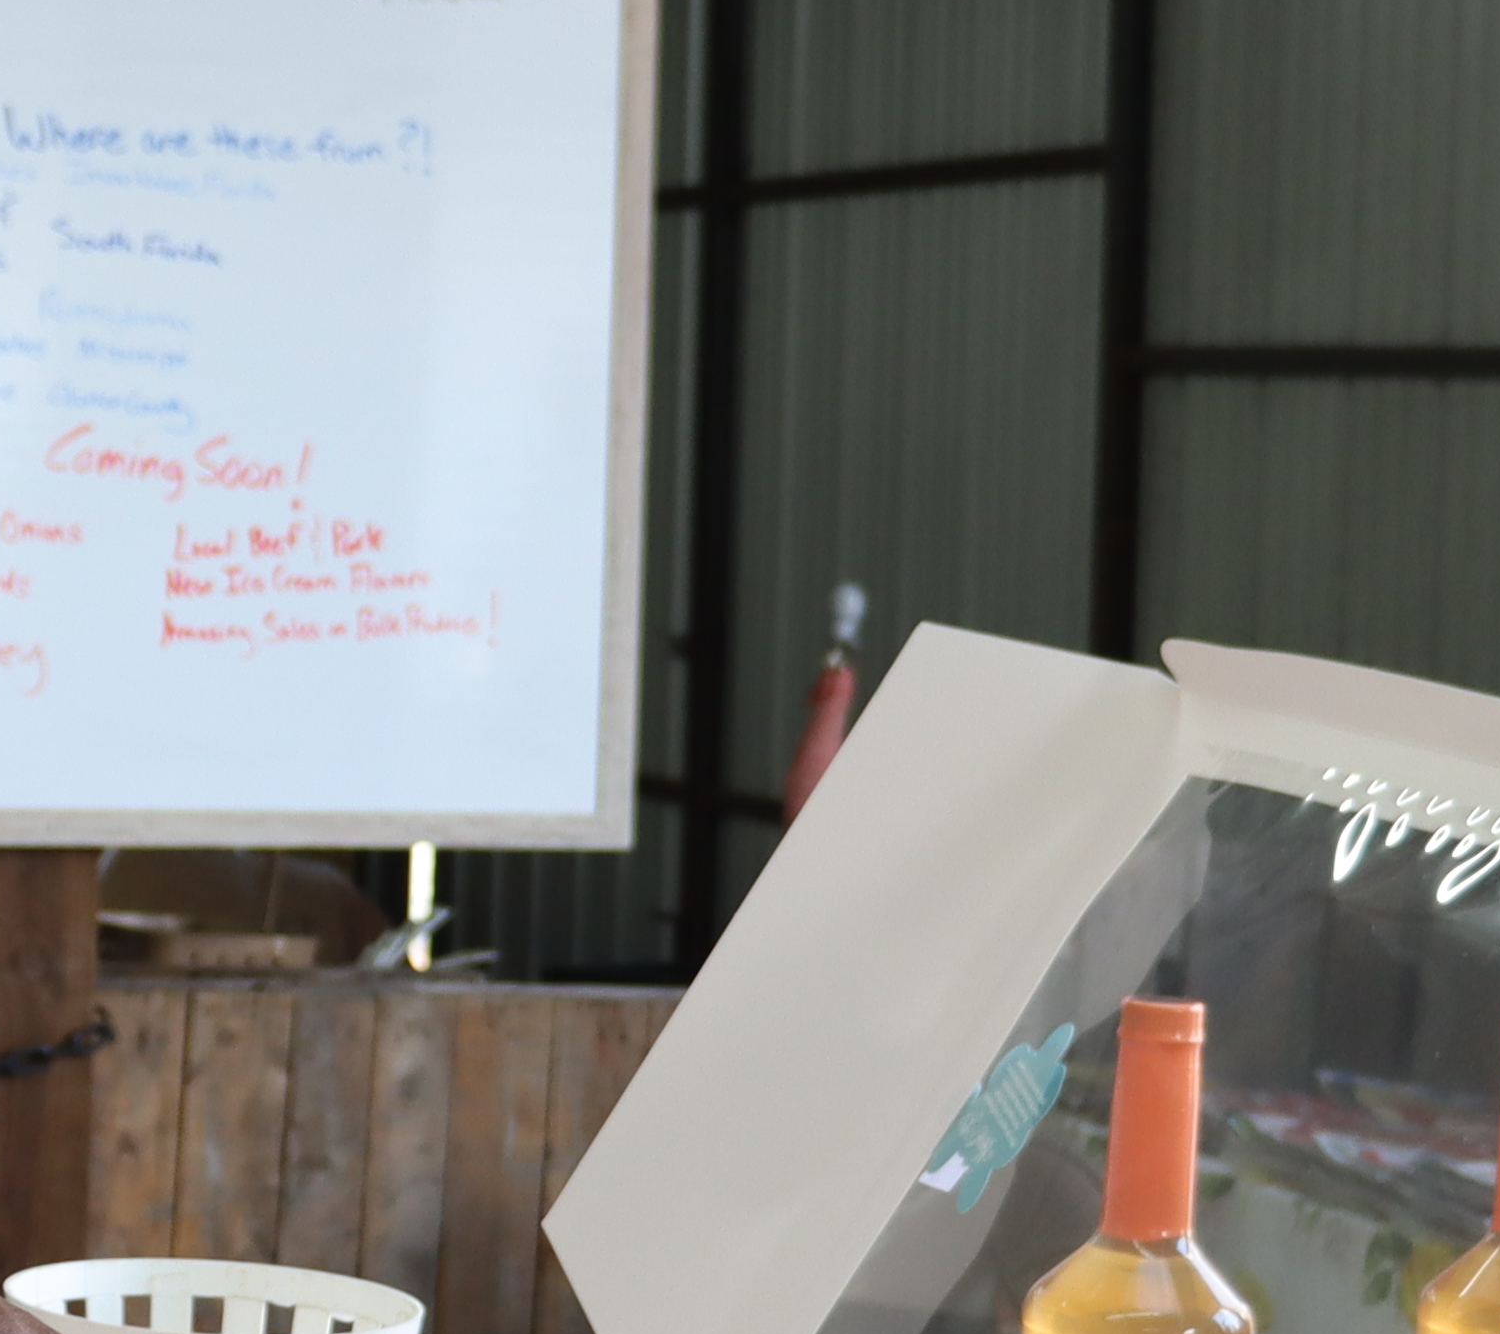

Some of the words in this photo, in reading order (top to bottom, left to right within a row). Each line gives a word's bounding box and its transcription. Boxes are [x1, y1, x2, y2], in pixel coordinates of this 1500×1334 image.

[1, 101, 126, 157] Where
[142, 122, 198, 158] are
[208, 122, 300, 163] these
[309, 125, 384, 166] from
[45, 422, 188, 504] Coming
[194, 433, 316, 512] Soon!
[172, 520, 238, 563] Local
[248, 520, 303, 559] Beef
[330, 518, 387, 558] Pork
[164, 567, 214, 599] New
[220, 565, 267, 597] Ice
[271, 564, 338, 593] Cream
